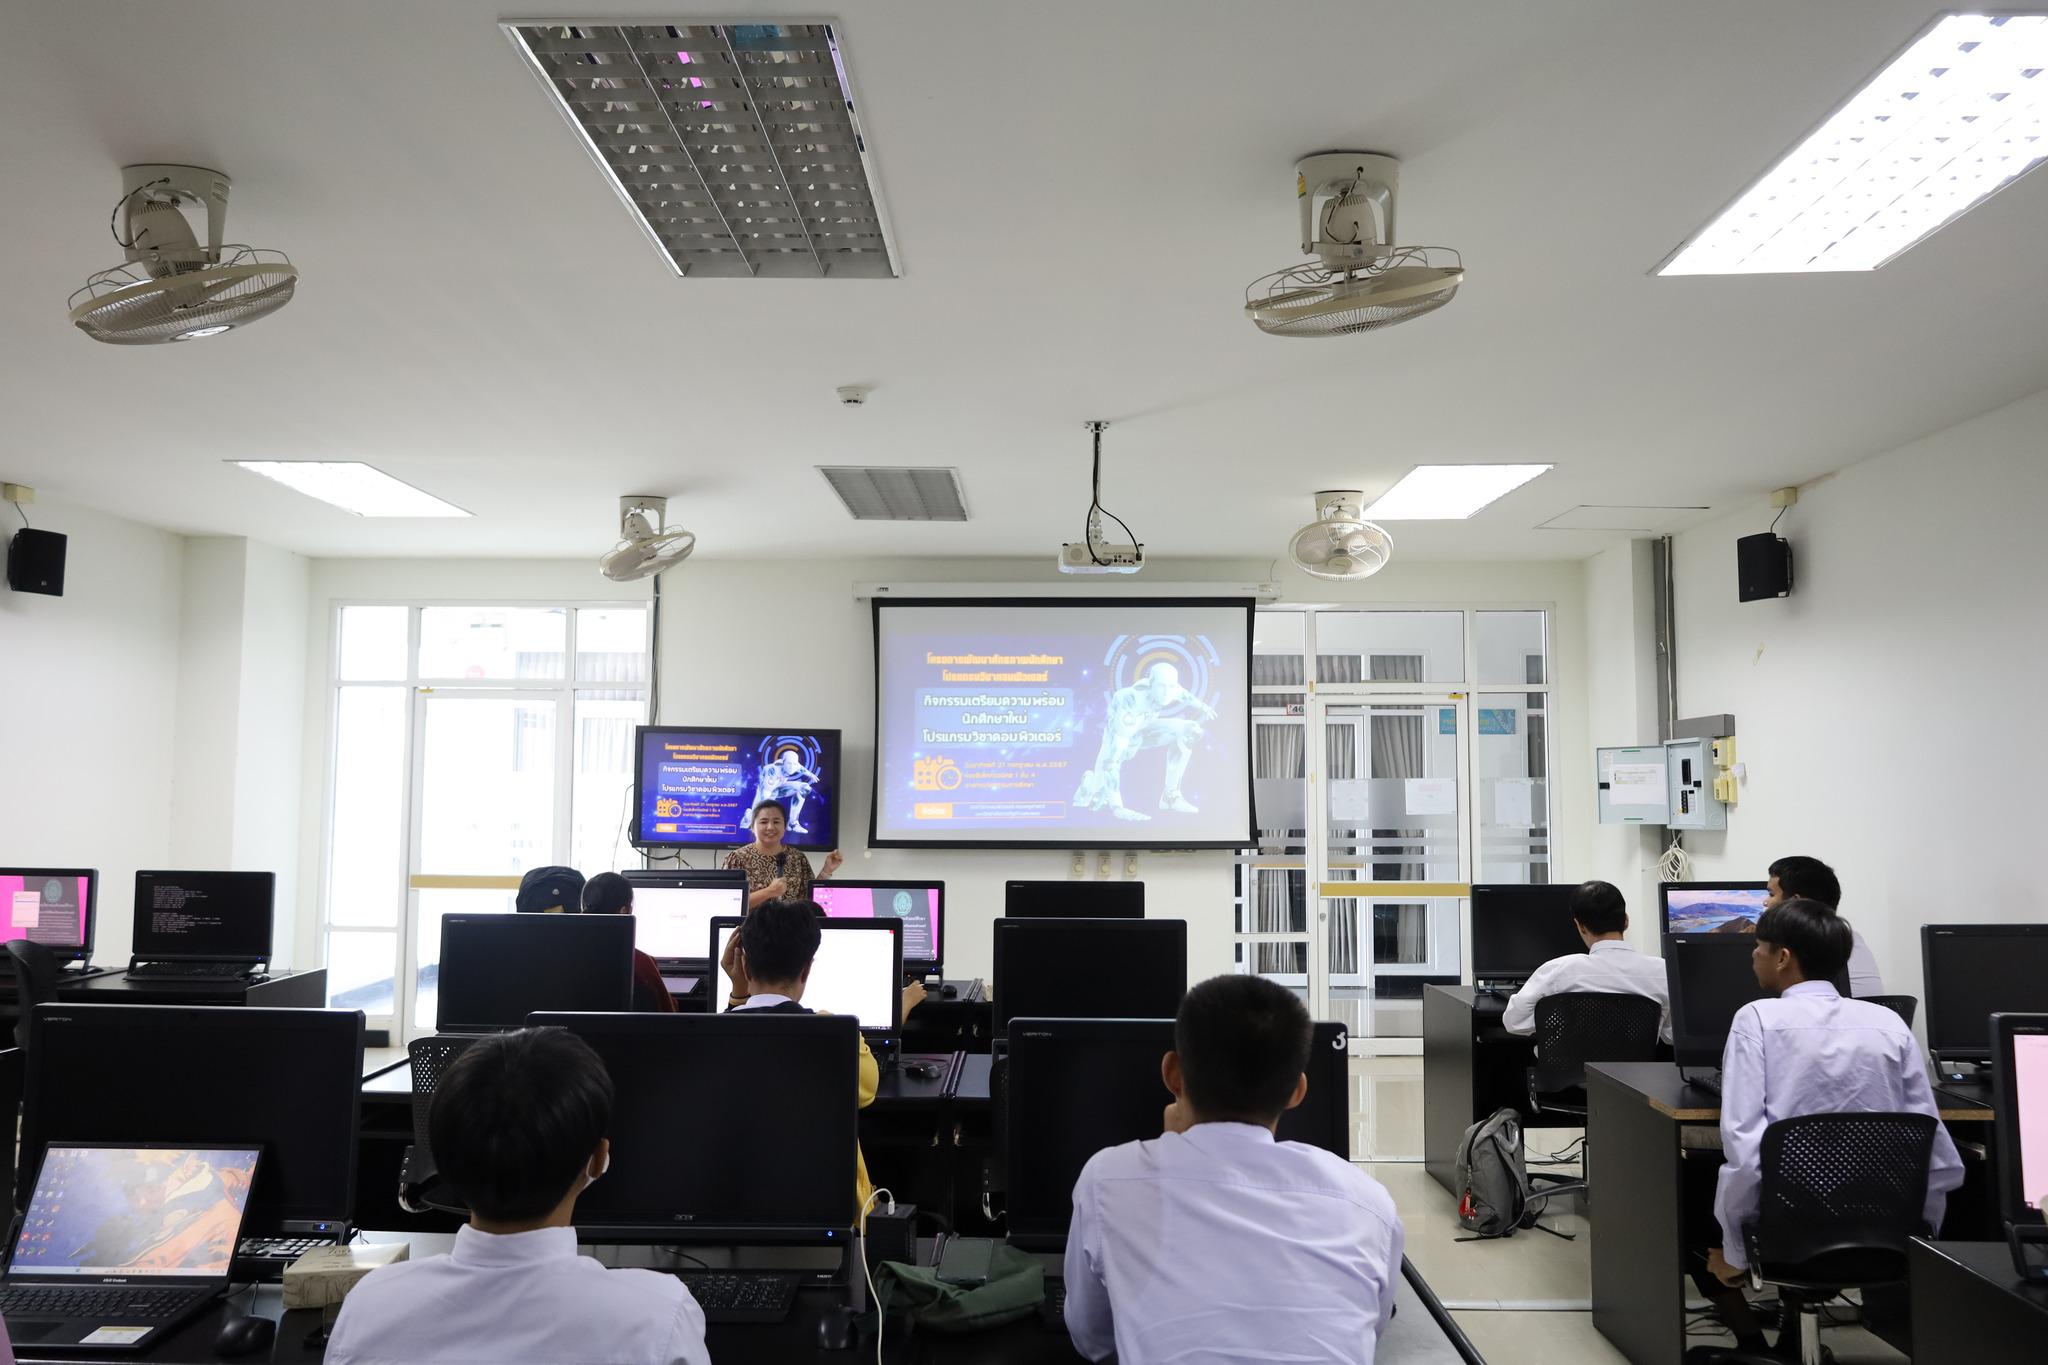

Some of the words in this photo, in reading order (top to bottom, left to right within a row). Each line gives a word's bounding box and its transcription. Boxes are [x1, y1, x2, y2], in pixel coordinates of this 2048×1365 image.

[923, 691, 1065, 707] กิจกรรมเตรียมความพร้อม
[962, 709, 1028, 725] นักศึกษาใหม่
[922, 728, 1062, 743] โปรแกรมวิชาคอมพิวเตอร์
[1332, 1031, 1346, 1050] 3
